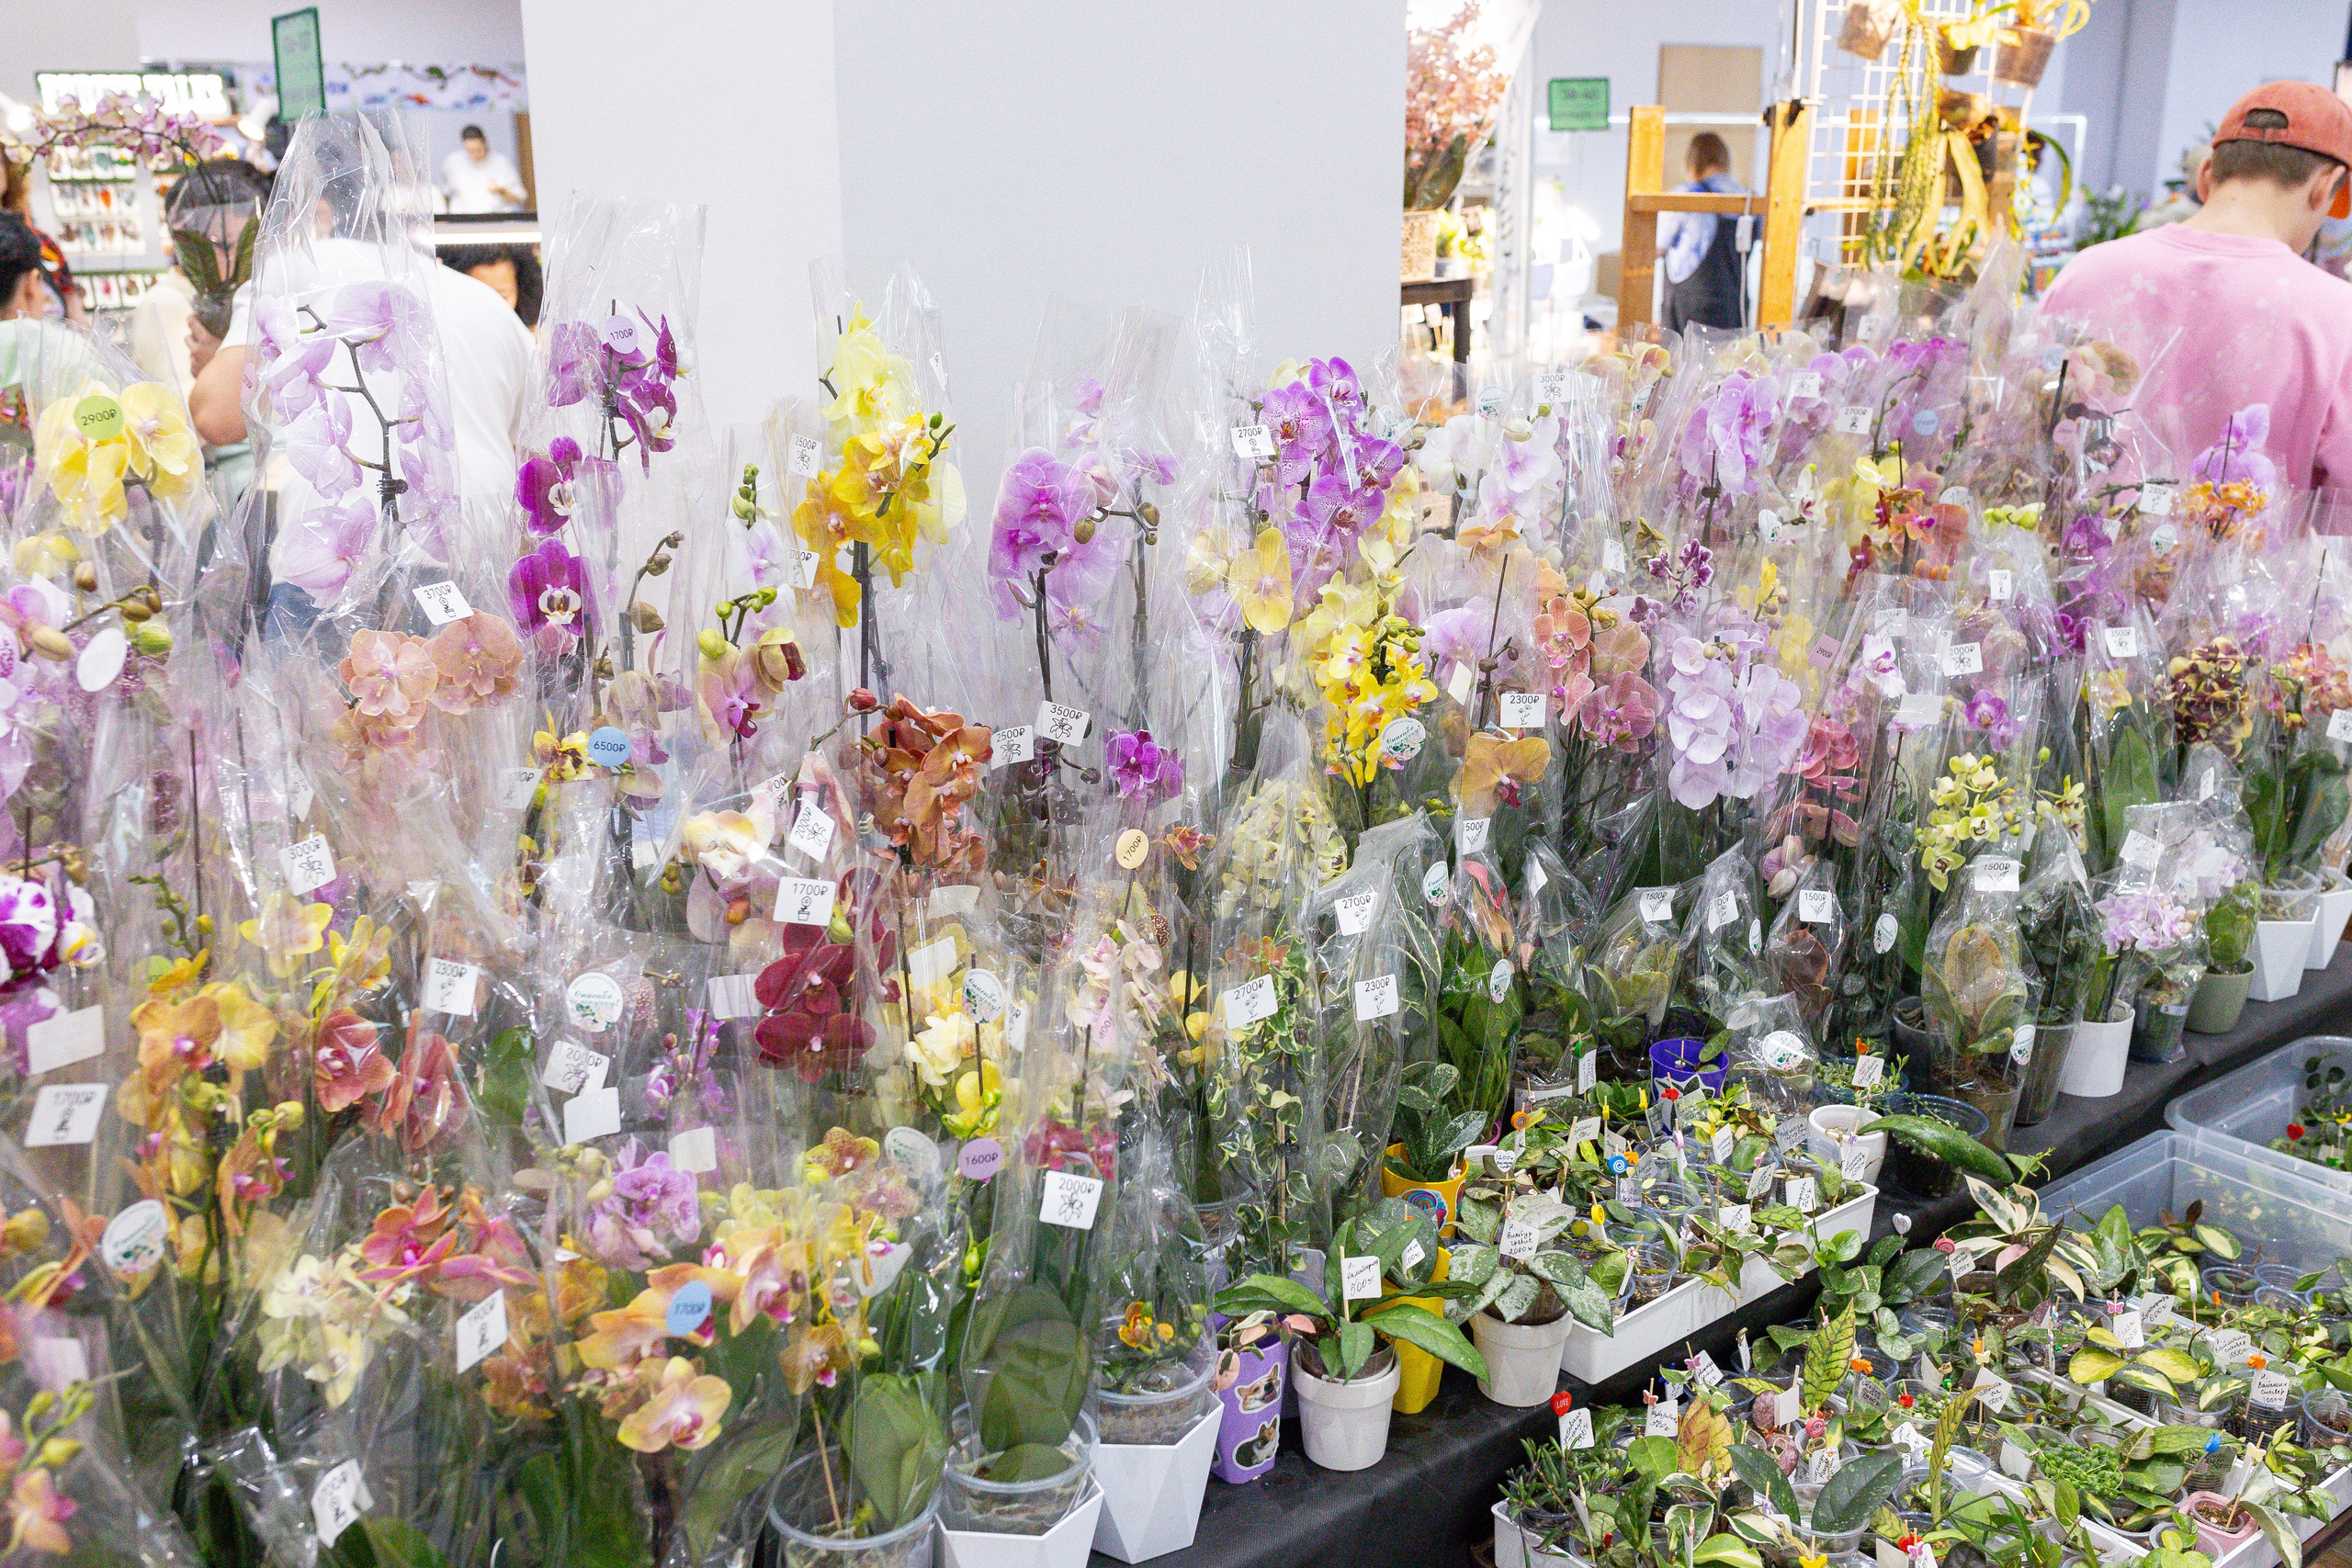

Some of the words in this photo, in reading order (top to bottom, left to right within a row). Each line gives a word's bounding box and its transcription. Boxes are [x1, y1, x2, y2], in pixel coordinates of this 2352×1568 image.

[610, 328, 634, 342] 1700₽
[1540, 374, 1566, 383] 3000₽
[81, 407, 117, 427] 2900₽
[1238, 426, 1262, 438] 2700₽
[795, 434, 818, 451] 2500₽
[425, 584, 452, 600] 3700₽
[1950, 645, 1975, 656] 2000₽
[1510, 694, 1540, 705] 2300₽
[1049, 704, 1083, 720] 3500₽
[996, 727, 1025, 742] 2500₽
[594, 740, 627, 753] 6500₽
[794, 806, 812, 841] 2000₽
[289, 838, 322, 861] 3000₽
[1123, 834, 1143, 863] 1700₽
[1984, 863, 2011, 872] 1500₽
[793, 882, 829, 897] 1700₽
[1645, 891, 1668, 901] 1500₽
[1804, 892, 1827, 902] 1500₽
[1341, 894, 1372, 909] 2700₽
[1234, 978, 1265, 1000] 2700₽
[1364, 976, 1390, 993] 2300₽
[567, 1050, 603, 1067] 2000₽
[965, 1152, 999, 1167] 1600₽
[1059, 1178, 1095, 1194] 2000₽
[1555, 1397, 1569, 1410] LOVE
